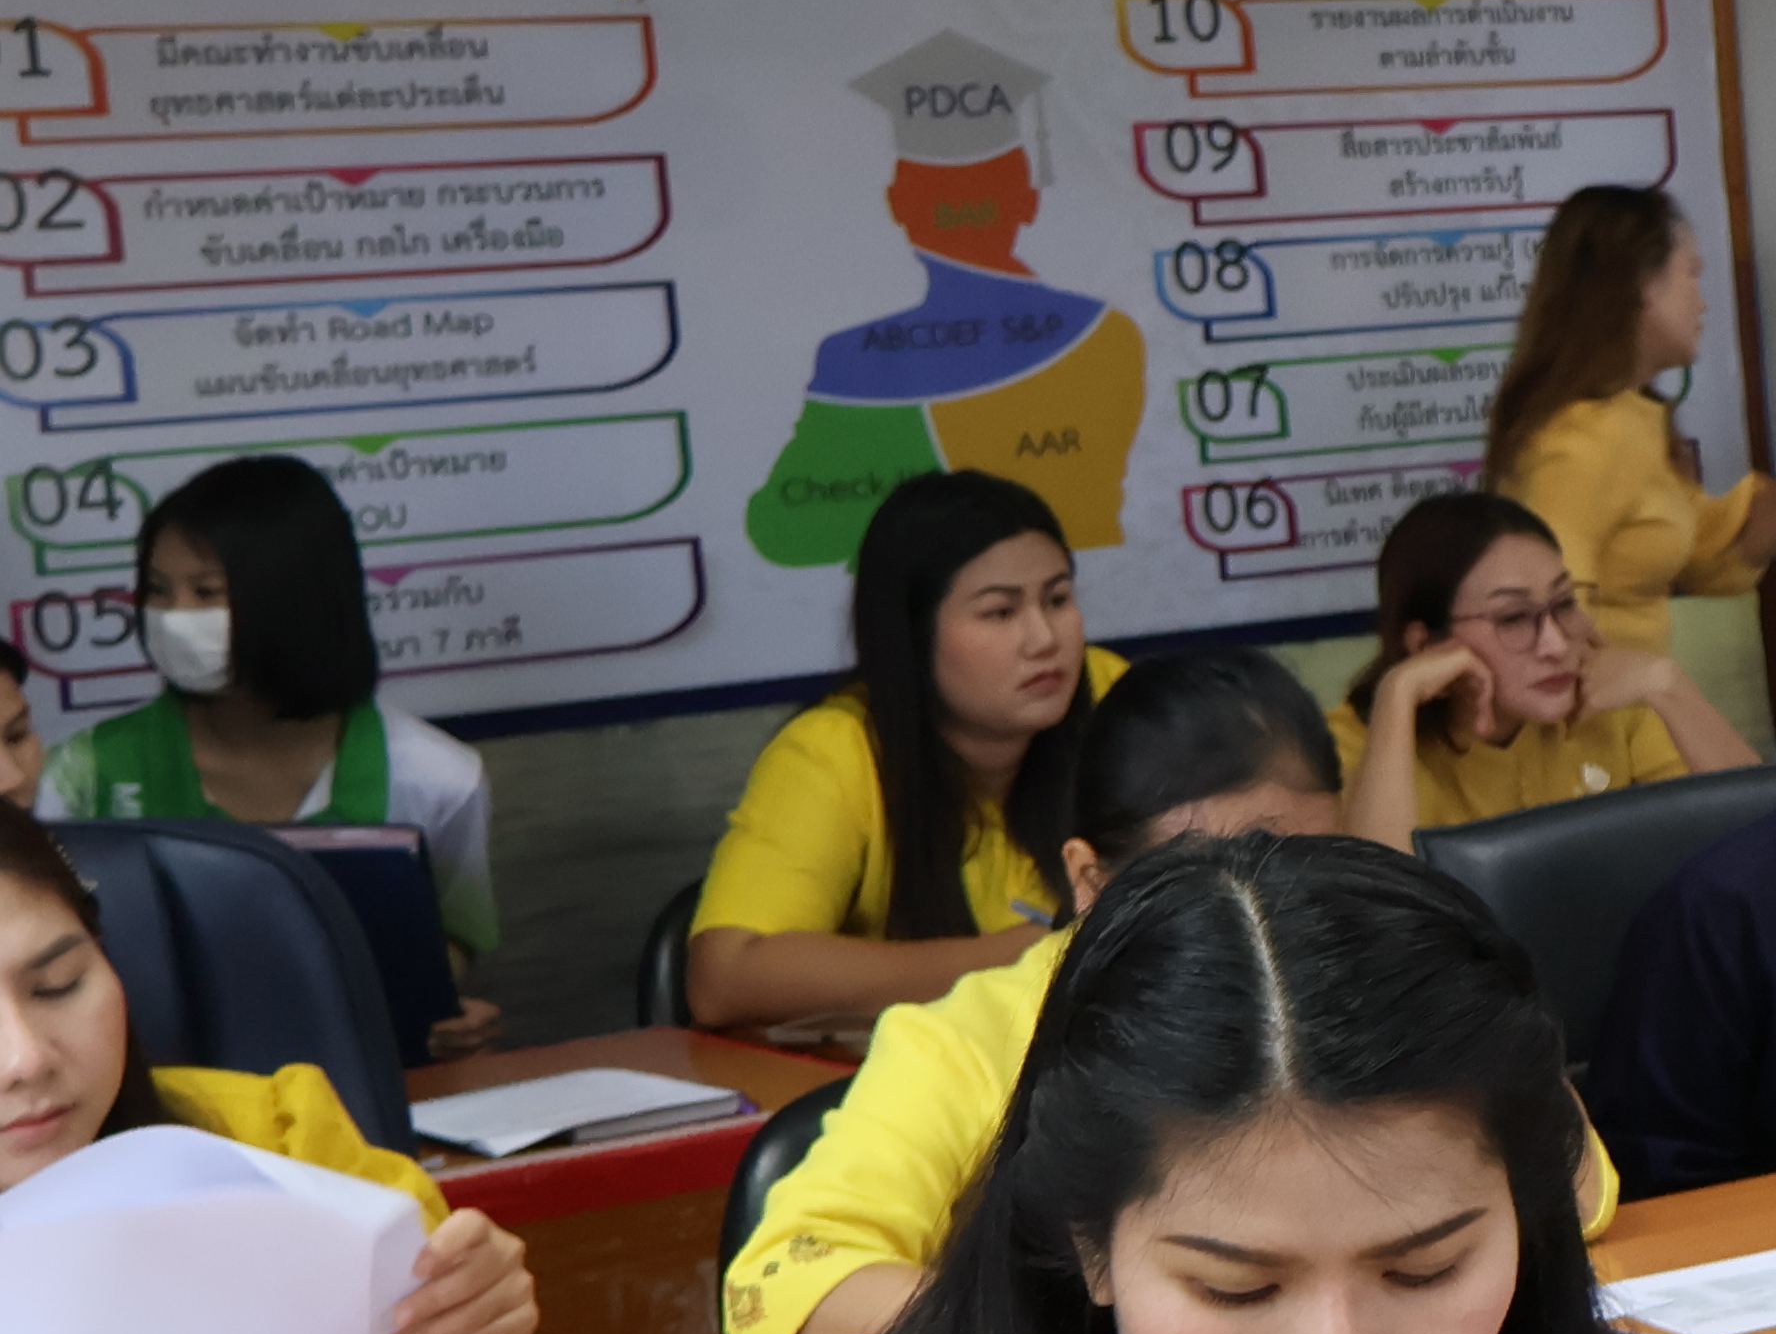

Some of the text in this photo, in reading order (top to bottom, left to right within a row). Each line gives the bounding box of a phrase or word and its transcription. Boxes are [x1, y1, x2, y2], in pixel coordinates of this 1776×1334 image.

[905, 82, 1013, 119] PDCA
[1162, 117, 1243, 175] 09
[436, 175, 606, 210] กระบวนการ
[199, 225, 344, 269] ขับเคลื่อน
[356, 221, 430, 260] กลไก
[1173, 236, 1250, 294] 08
[0, 316, 99, 379] 03
[232, 311, 495, 348] จัดทำ Road Map
[1195, 363, 1270, 424] 07
[1016, 427, 1082, 459] AAR
[20, 460, 125, 528] 04
[779, 471, 884, 507] Check
[1202, 477, 1277, 535] 06
[30, 587, 136, 652] 05
[433, 628, 451, 653] 7
